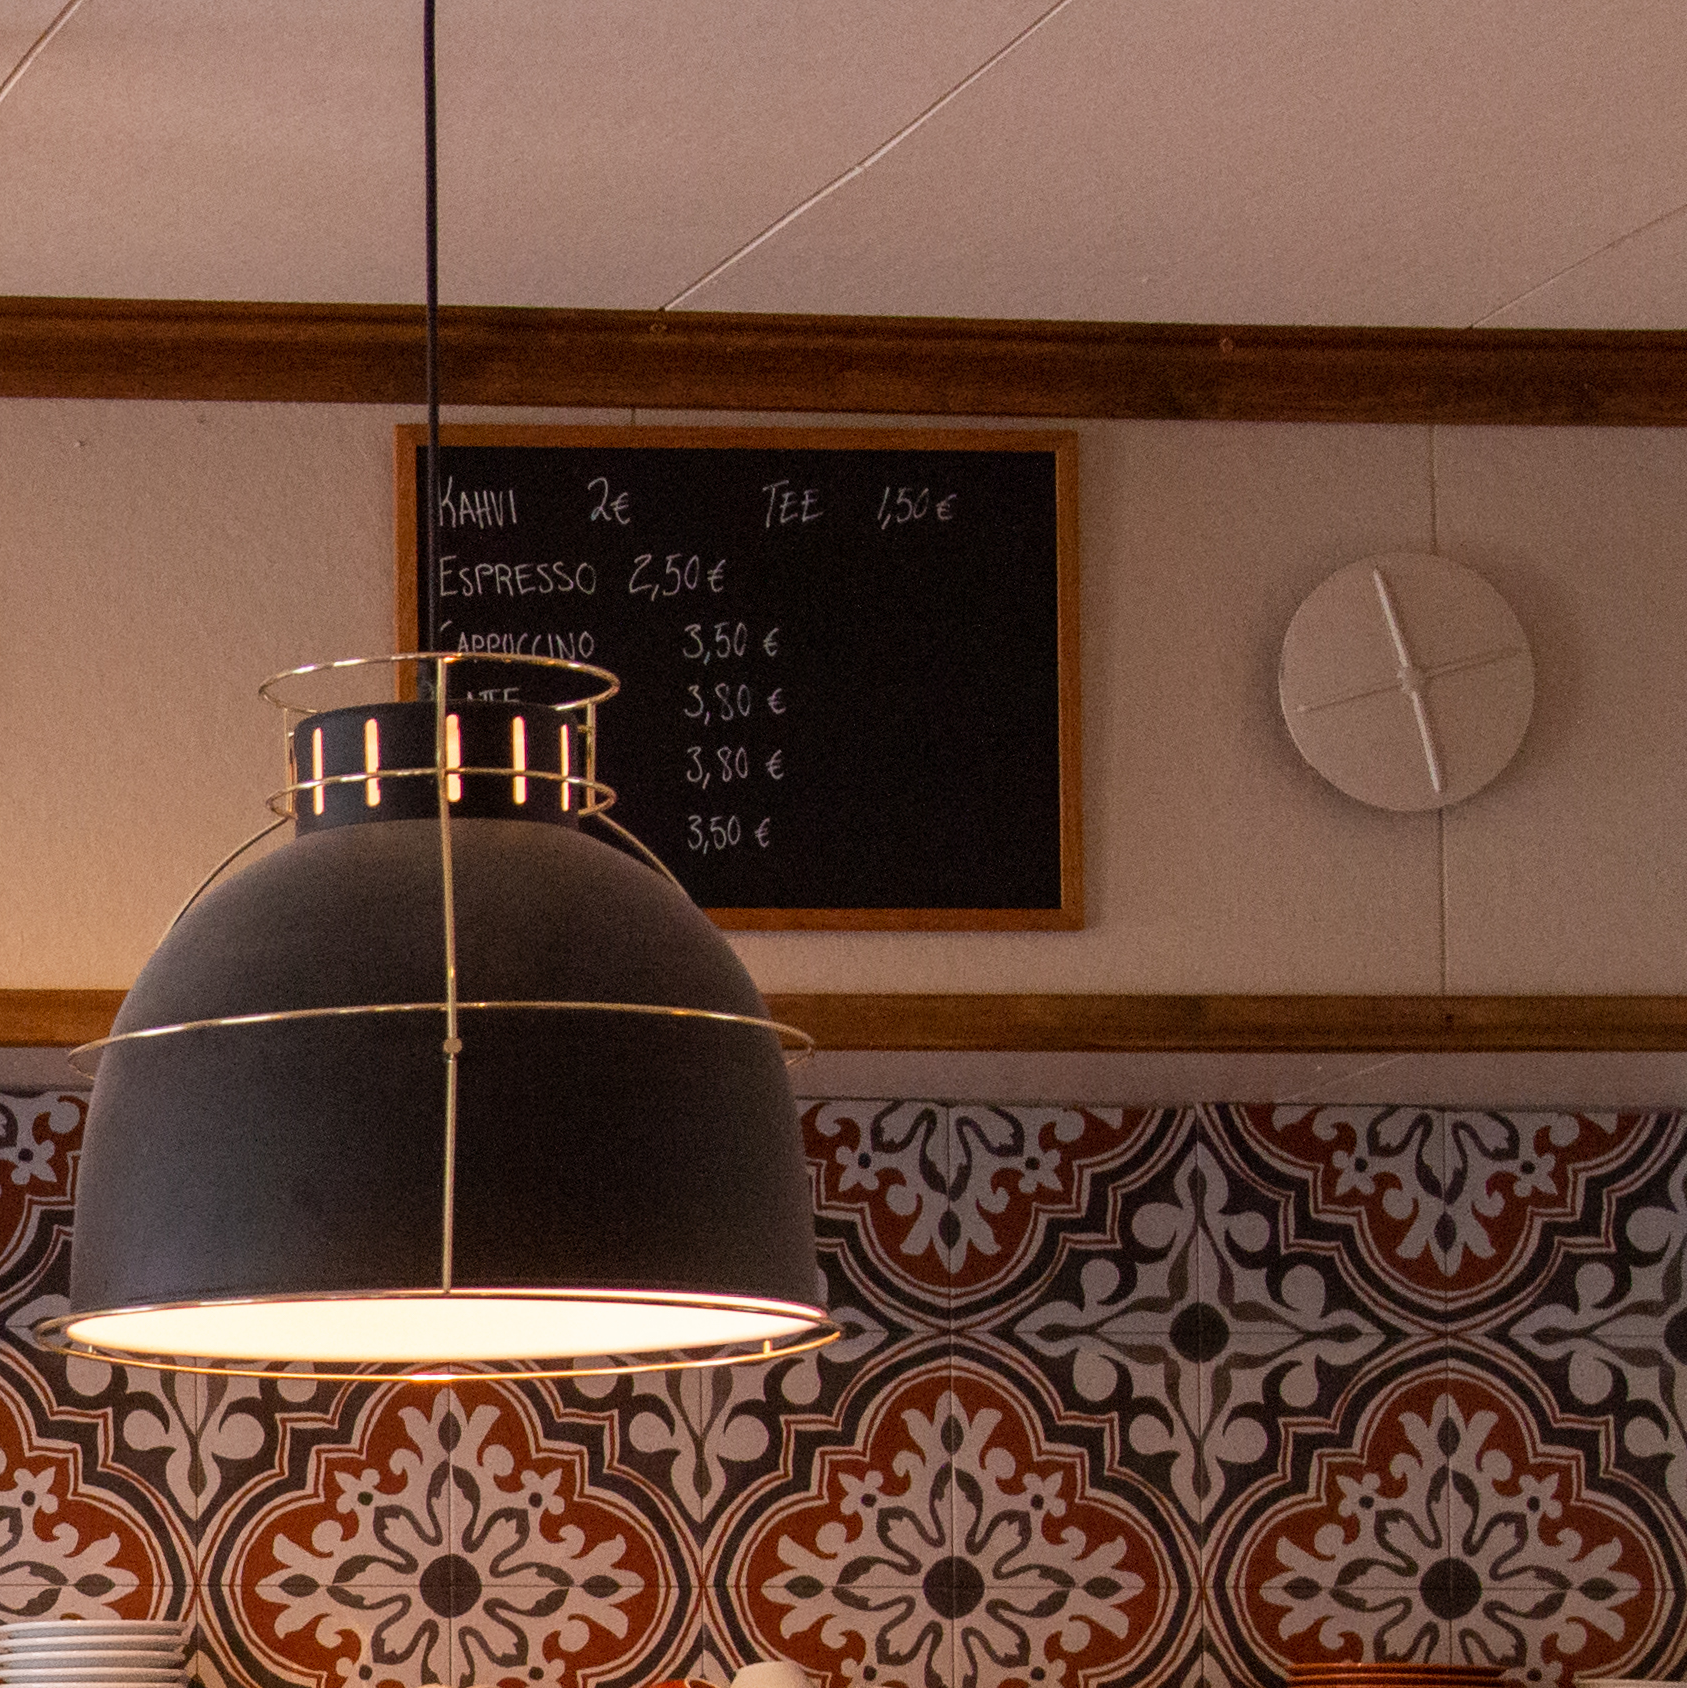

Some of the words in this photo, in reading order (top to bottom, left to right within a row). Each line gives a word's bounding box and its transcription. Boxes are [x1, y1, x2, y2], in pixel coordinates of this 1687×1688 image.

[438, 475, 518, 530] KAHVI
[586, 476, 632, 525] 2€
[762, 480, 824, 528] TEE
[439, 554, 597, 598] ESPRESSO
